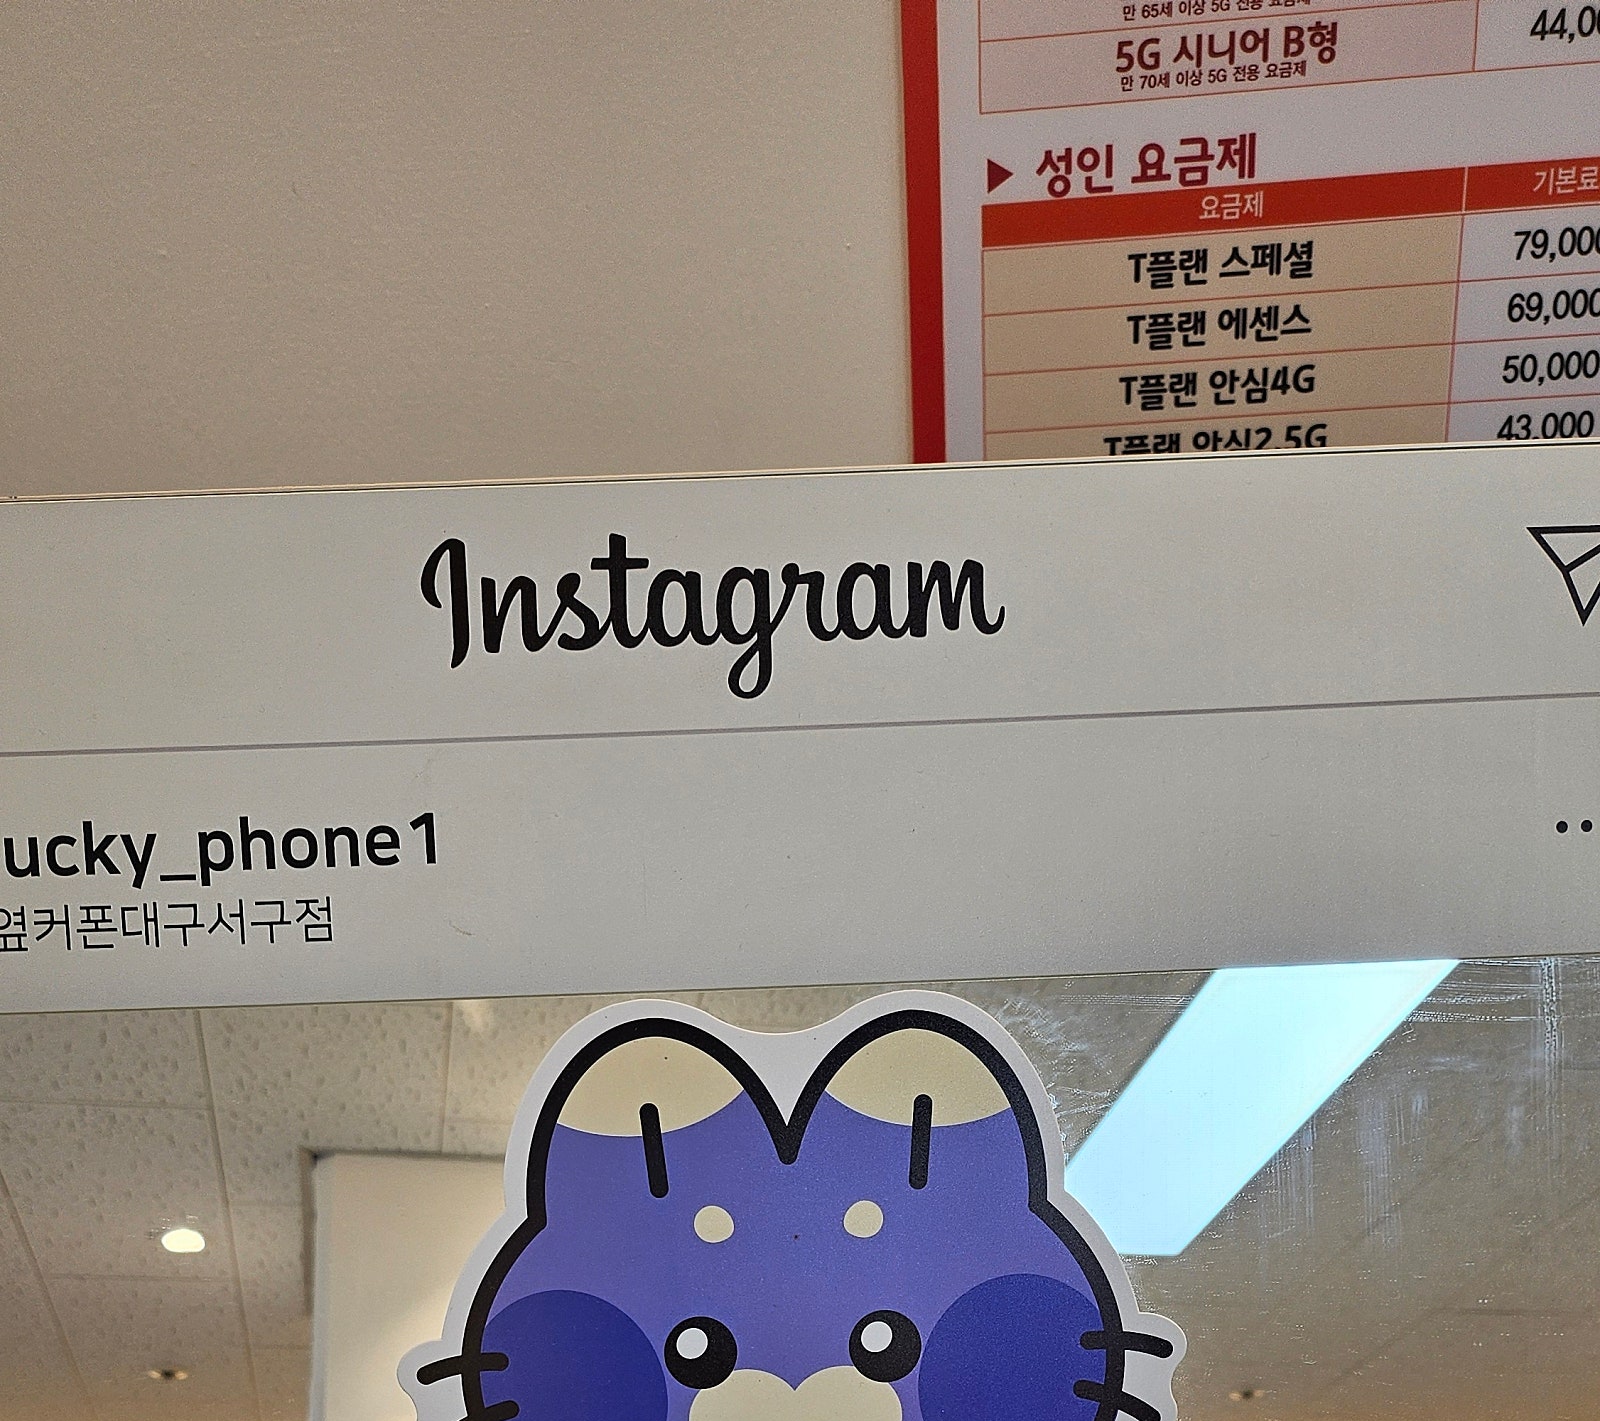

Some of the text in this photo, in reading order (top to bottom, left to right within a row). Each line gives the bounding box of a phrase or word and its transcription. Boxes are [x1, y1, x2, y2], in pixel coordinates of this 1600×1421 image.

[1123, 4, 1136, 21] 만
[1141, 4, 1173, 18] 65세
[1179, 0, 1205, 15] 이상
[1529, 5, 1600, 43] 44,0
[1115, 21, 1338, 73] 5G 시니어 B형
[1121, 60, 1307, 92] 만 70세 이상 5G 전용 요금제
[1036, 132, 1257, 198] 성인 요금제
[1532, 165, 1600, 196] 기본료
[1199, 191, 1264, 220] 요금제
[1127, 240, 1314, 290] T플랜 스페셜
[1126, 303, 1312, 351] T플랜 에센스
[1119, 364, 1316, 411] T플랜 안심4G
[1502, 349, 1600, 387] 50,000
[420, 532, 1006, 700] Instagram
[3, 812, 437, 890] ucky_phone1
[0, 896, 333, 953] 옆커폰대구서구점
